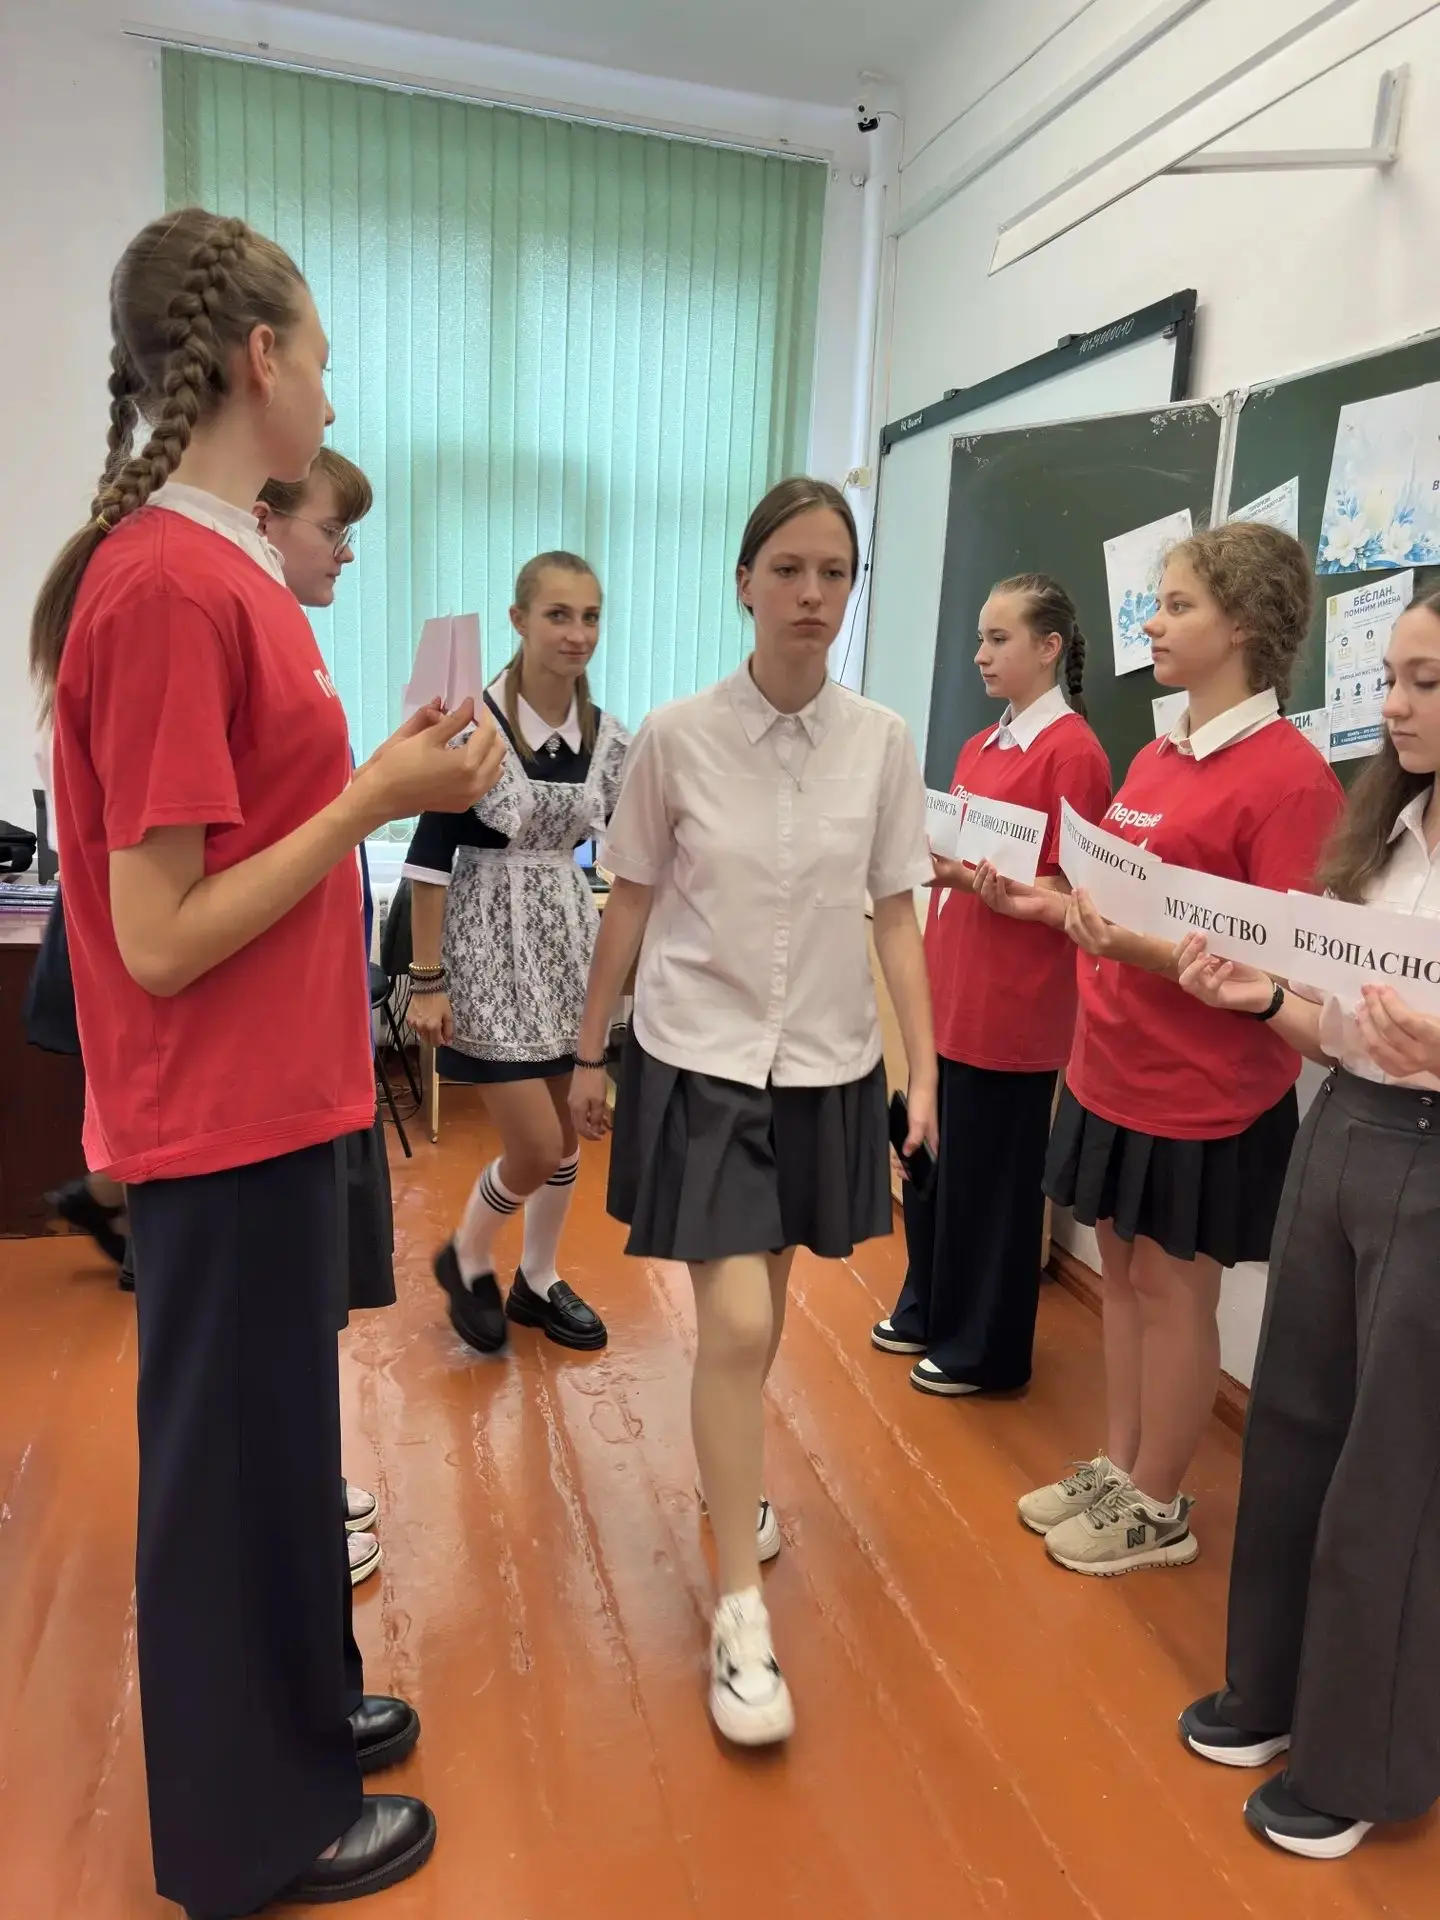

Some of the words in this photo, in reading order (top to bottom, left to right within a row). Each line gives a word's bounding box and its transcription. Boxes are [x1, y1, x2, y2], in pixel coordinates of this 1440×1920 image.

[1344, 603, 1376, 618] ПОМНИМ
[1377, 594, 1401, 608] ИМЕНА
[1353, 585, 1395, 606] БЕСЛАН.
[967, 808, 1040, 844] НЕРАВНОДУШИЕ
[1104, 803, 1163, 828] Первые
[1164, 897, 1267, 946] МУЖЕСТВО
[1294, 927, 1440, 984] БЕЗОПАСНО
